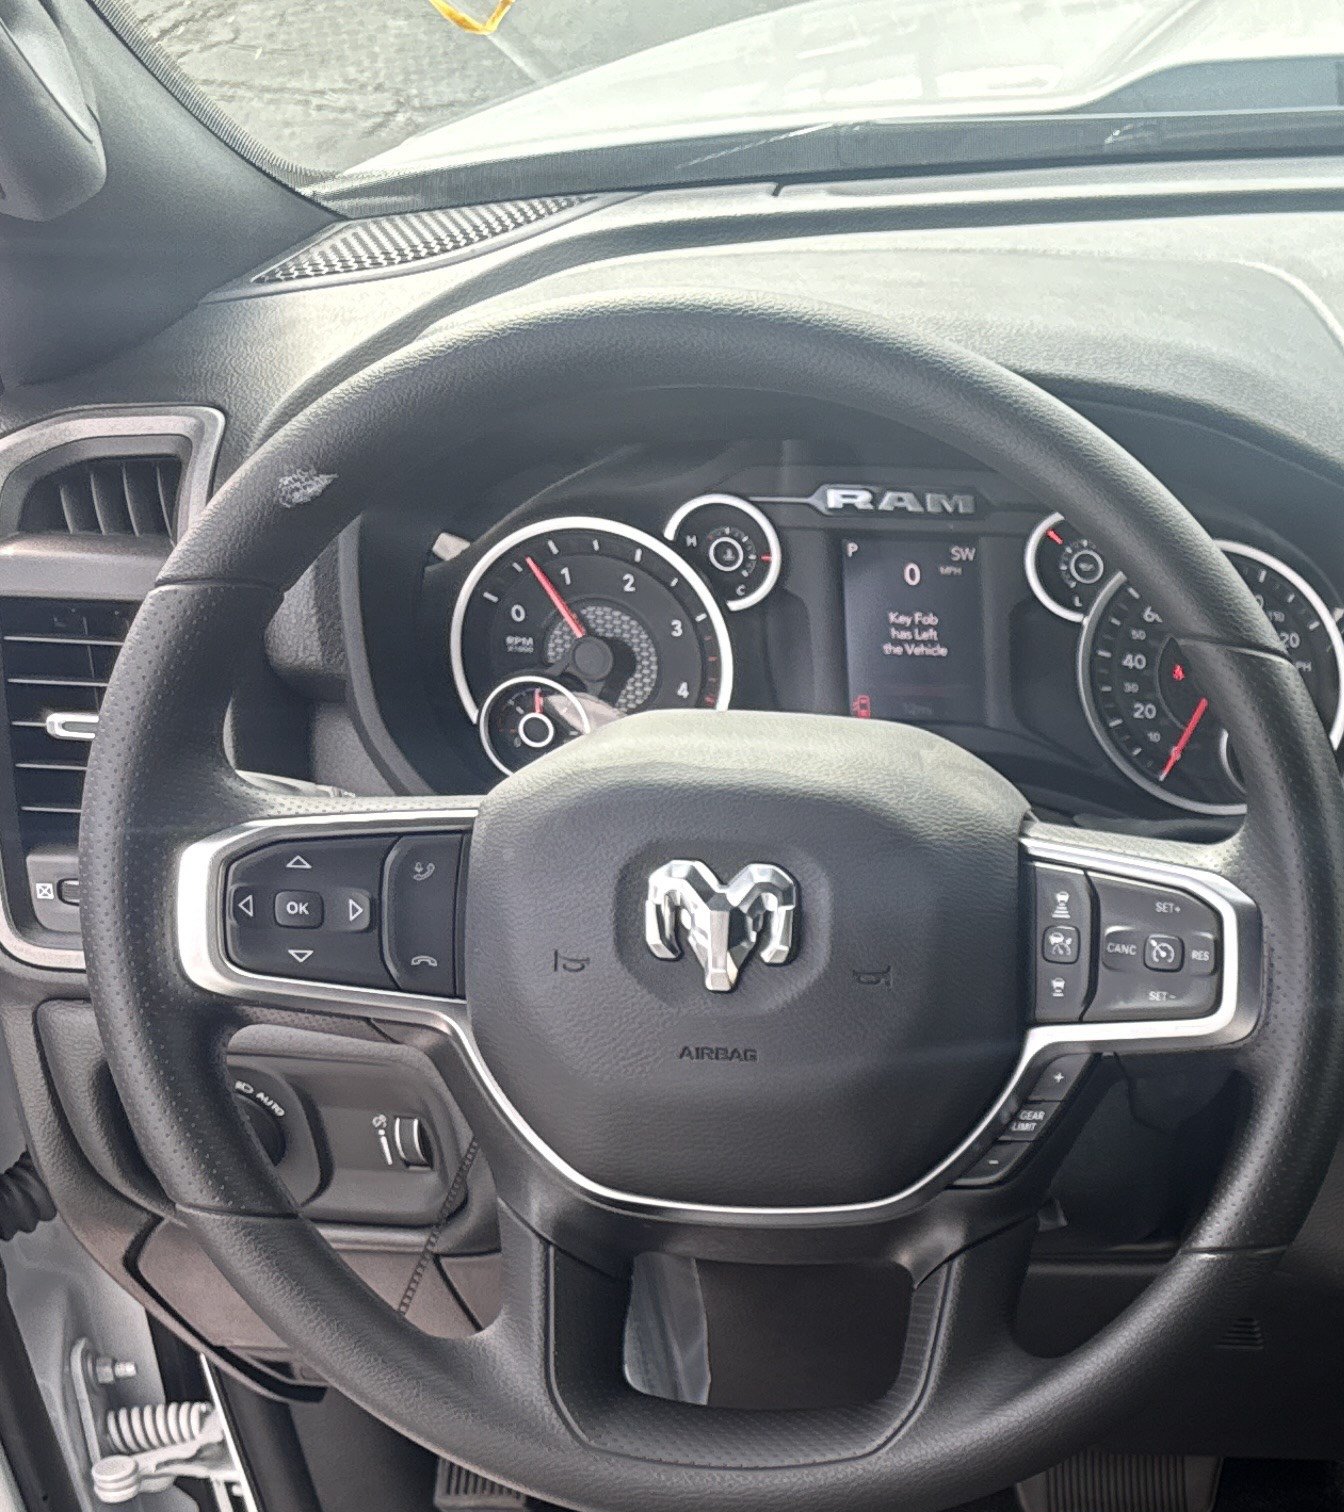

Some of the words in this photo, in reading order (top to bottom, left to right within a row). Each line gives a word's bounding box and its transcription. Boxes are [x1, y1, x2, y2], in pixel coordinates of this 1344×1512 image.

[826, 488, 976, 514] RAM
[846, 541, 859, 557] P
[950, 545, 976, 561] SW
[560, 566, 571, 586] 1
[622, 572, 636, 592] 2
[903, 562, 921, 586] 0
[510, 603, 526, 622] 0
[888, 611, 913, 627] Key
[914, 611, 939, 626] Fob
[670, 619, 683, 637] 3
[890, 627, 913, 641] has
[914, 627, 938, 641] Left
[883, 642, 904, 656] the
[904, 643, 948, 657] Vehicle
[1121, 653, 1147, 670] 40
[677, 681, 690, 699] 4
[1132, 702, 1157, 719] 20
[286, 900, 310, 915] OK
[1107, 942, 1138, 956] CANC
[1191, 949, 1210, 962] RES
[678, 1045, 758, 1062] AIRBAG
[255, 1091, 286, 1117] AUTO
[1019, 1110, 1046, 1121] GEAR
[1011, 1122, 1037, 1132] LIMIT
